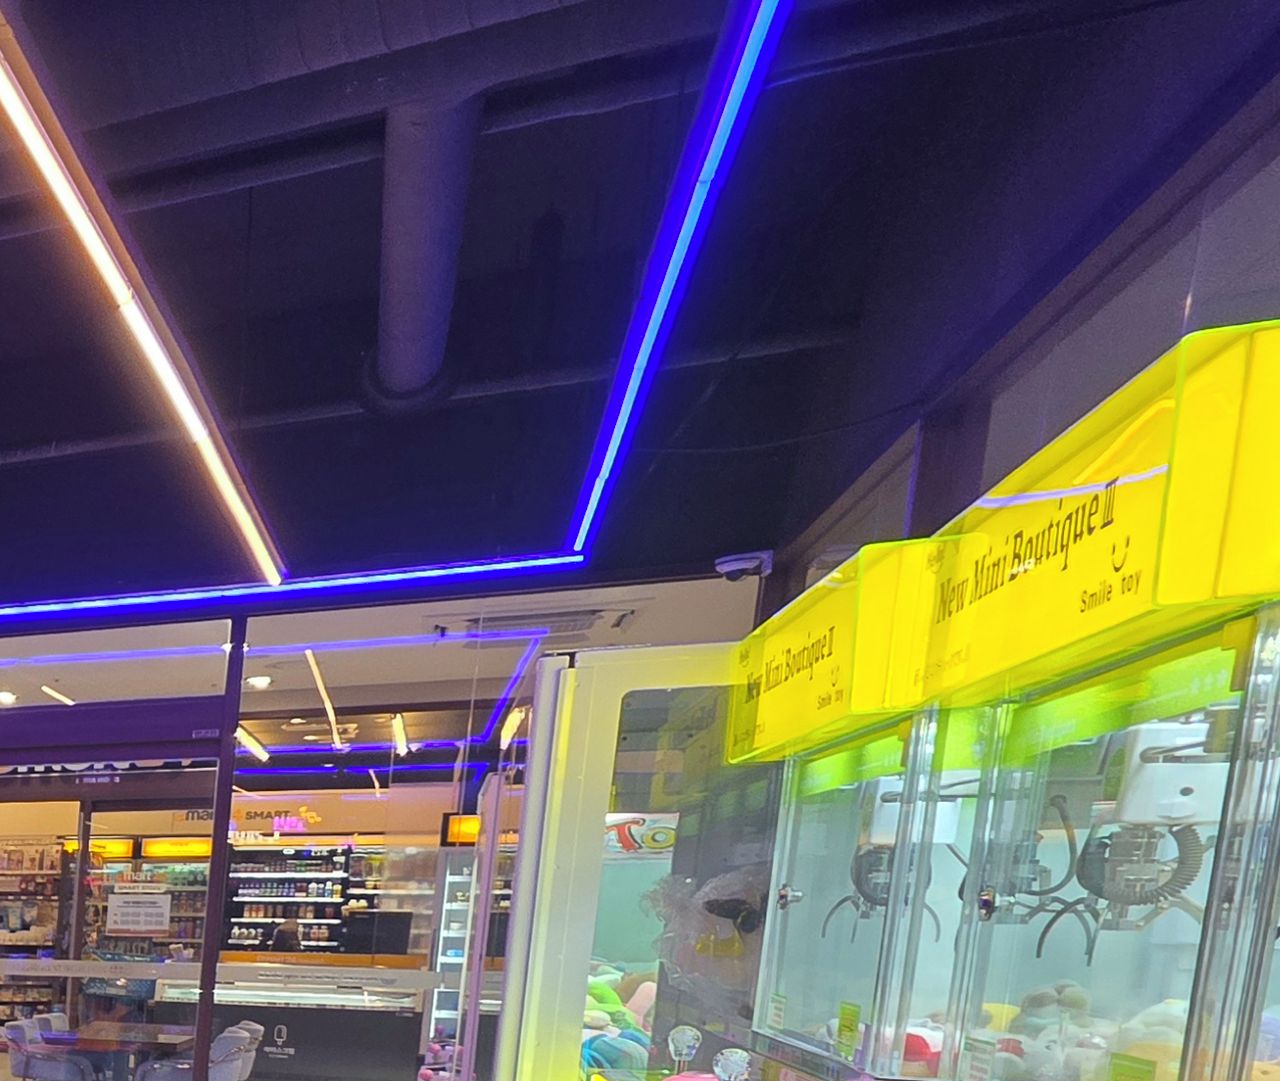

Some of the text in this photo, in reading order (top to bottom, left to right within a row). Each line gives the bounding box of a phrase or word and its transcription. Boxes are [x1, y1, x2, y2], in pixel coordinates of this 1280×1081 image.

[936, 577, 970, 624] New
[969, 537, 1010, 606] Mini
[1008, 493, 1100, 582] Boutique
[1080, 570, 1143, 614] Smile toy
[245, 810, 291, 821] SMART
